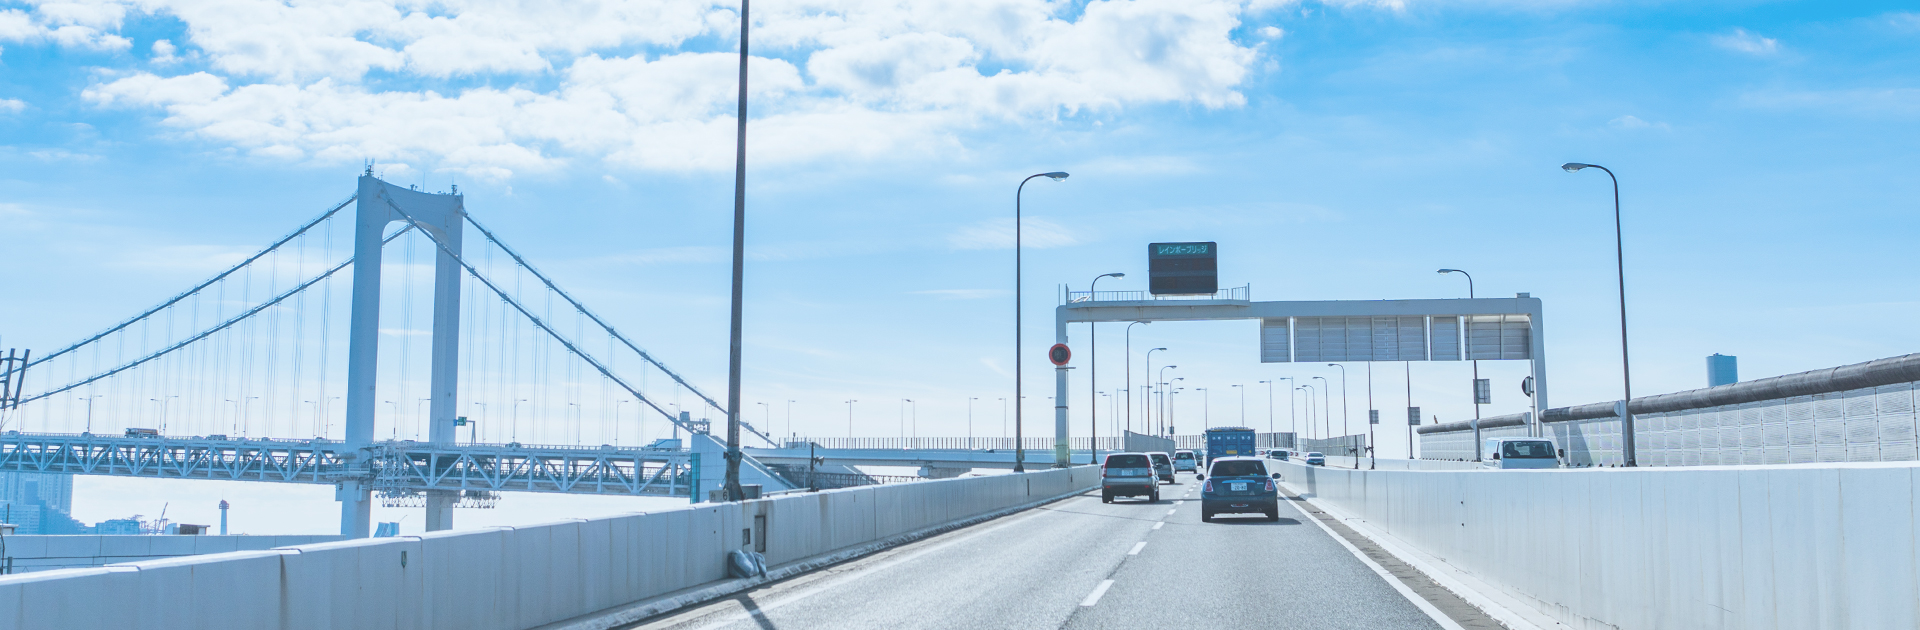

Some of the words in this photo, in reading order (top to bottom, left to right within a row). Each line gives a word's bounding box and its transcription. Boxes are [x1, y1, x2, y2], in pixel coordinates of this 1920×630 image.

[1159, 245, 1207, 254] レインボーブリッジ
